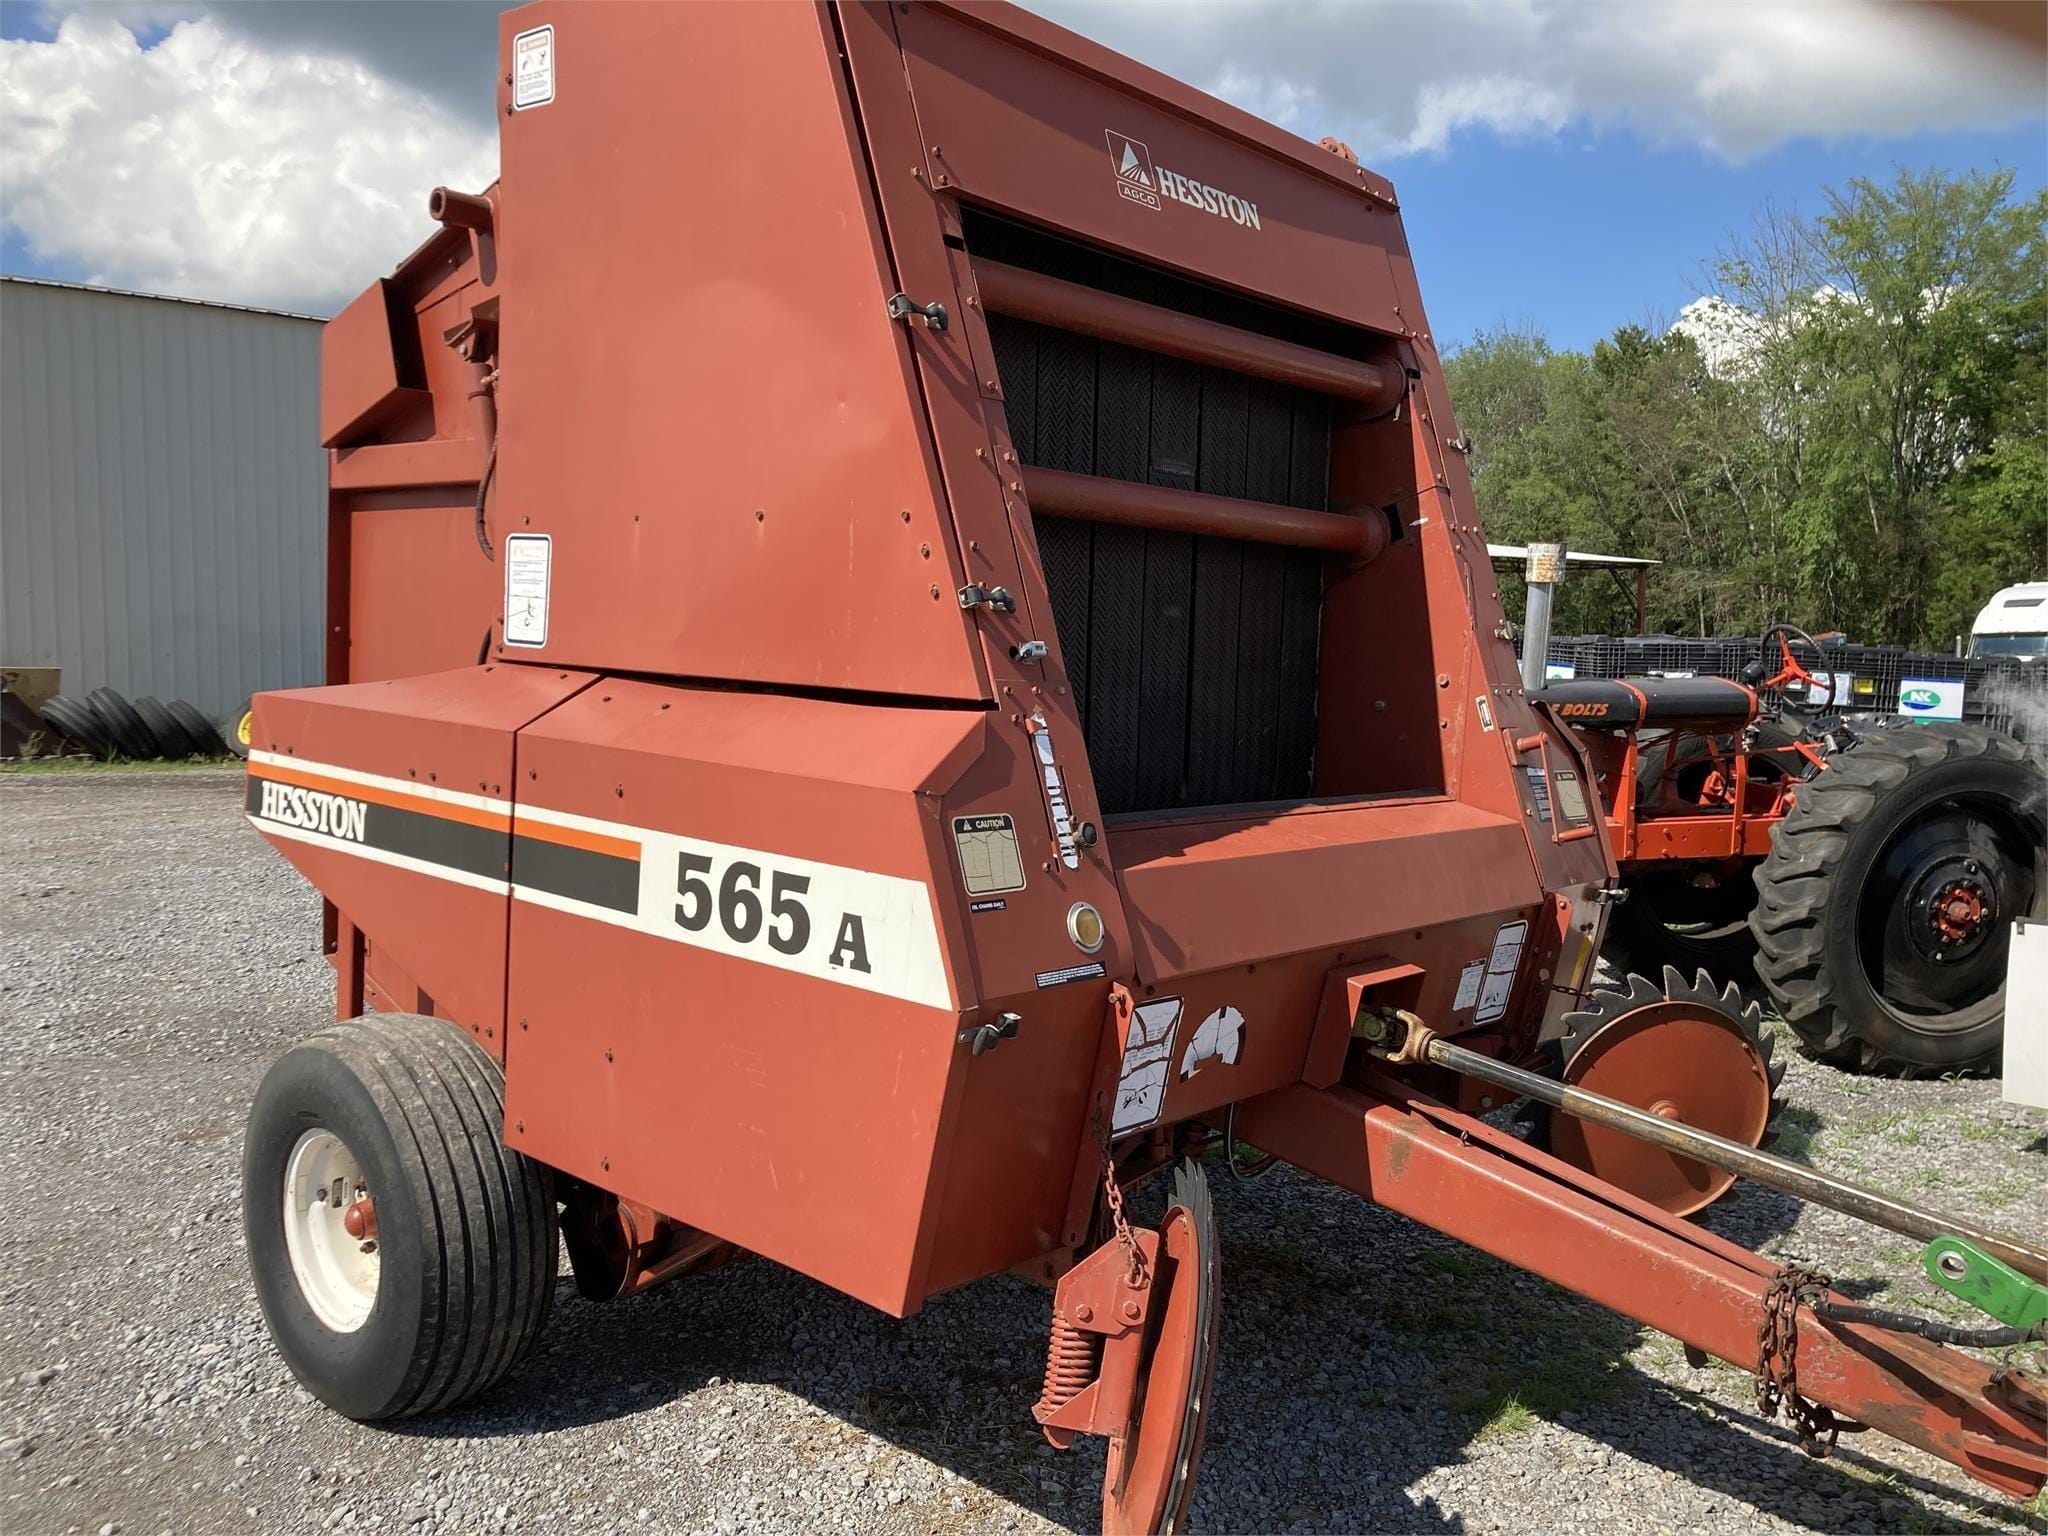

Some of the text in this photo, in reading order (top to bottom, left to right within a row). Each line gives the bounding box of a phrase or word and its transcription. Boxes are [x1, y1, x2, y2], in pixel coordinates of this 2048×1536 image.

[1124, 187, 1156, 205] AGCO
[1155, 166, 1261, 231] HESSTON
[1561, 703, 1609, 716] BOLTS
[260, 780, 367, 842] HESSTON
[975, 818, 1005, 829] CAUTION
[674, 851, 871, 974] 565 A
